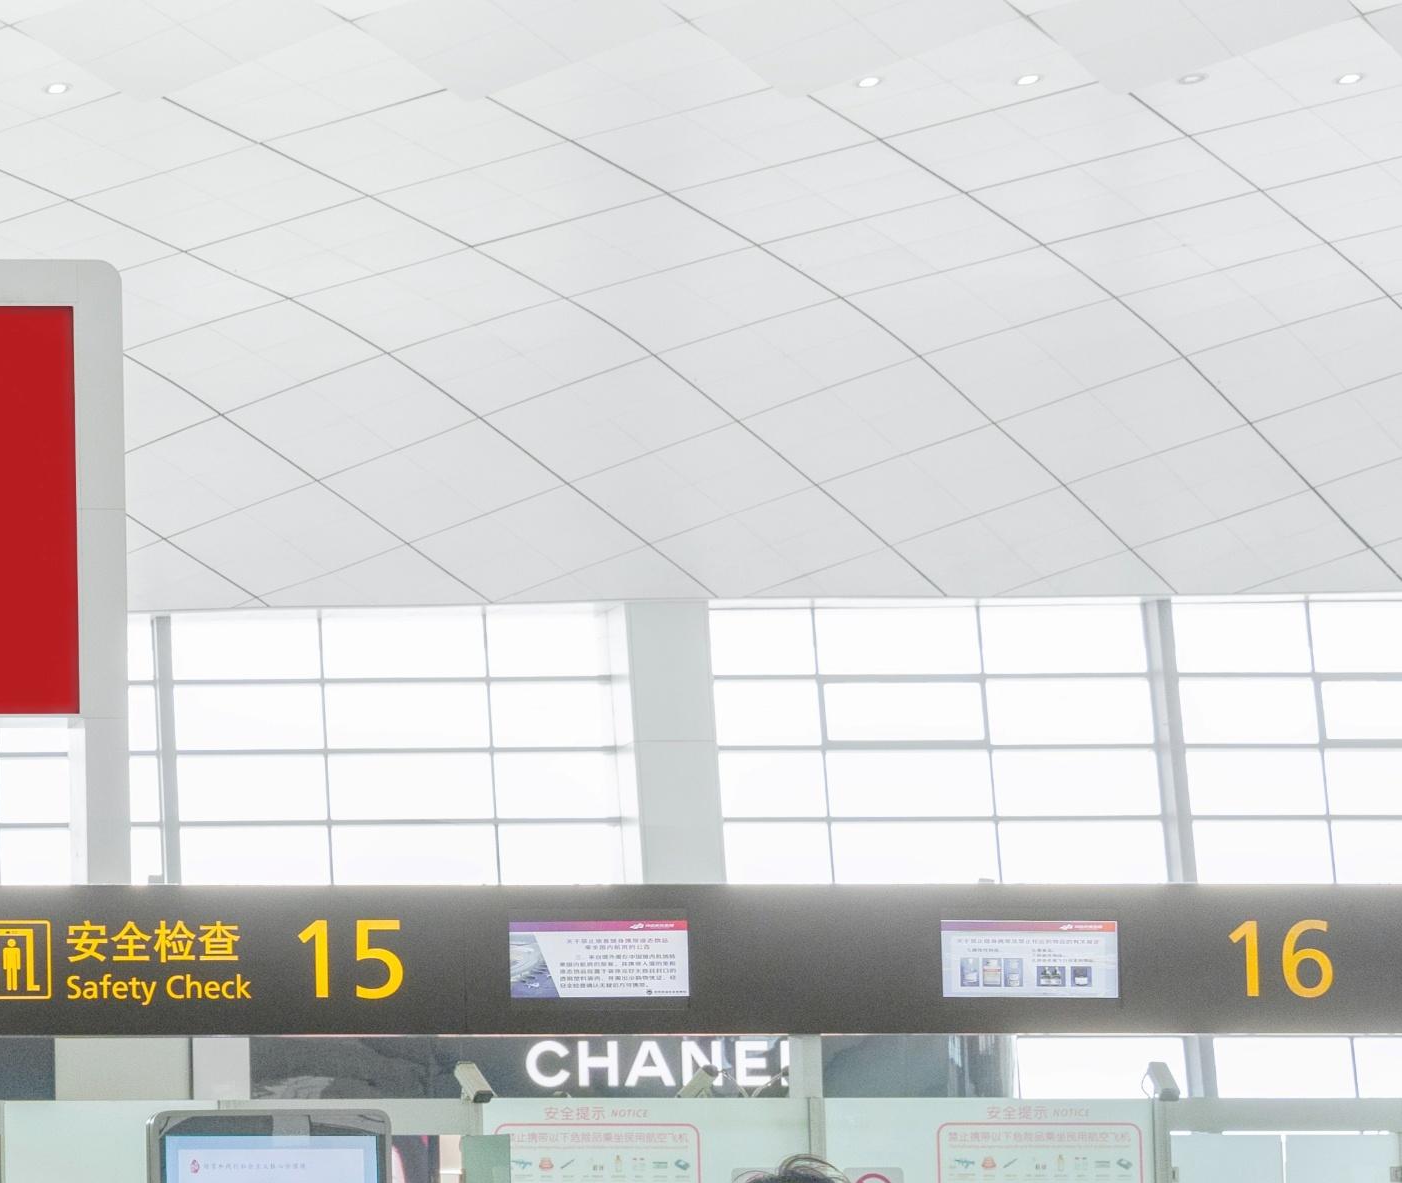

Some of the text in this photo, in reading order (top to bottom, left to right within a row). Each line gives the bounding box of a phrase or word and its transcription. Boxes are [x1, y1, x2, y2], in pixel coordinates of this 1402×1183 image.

[66, 920, 241, 964] 安全检查
[298, 919, 405, 1000] 15
[1230, 921, 1334, 997] 16
[66, 973, 252, 1006] Safety Check
[546, 1107, 648, 1120] 安全提示 NOTICE
[987, 1106, 1090, 1120] 安全提示 NOTICE
